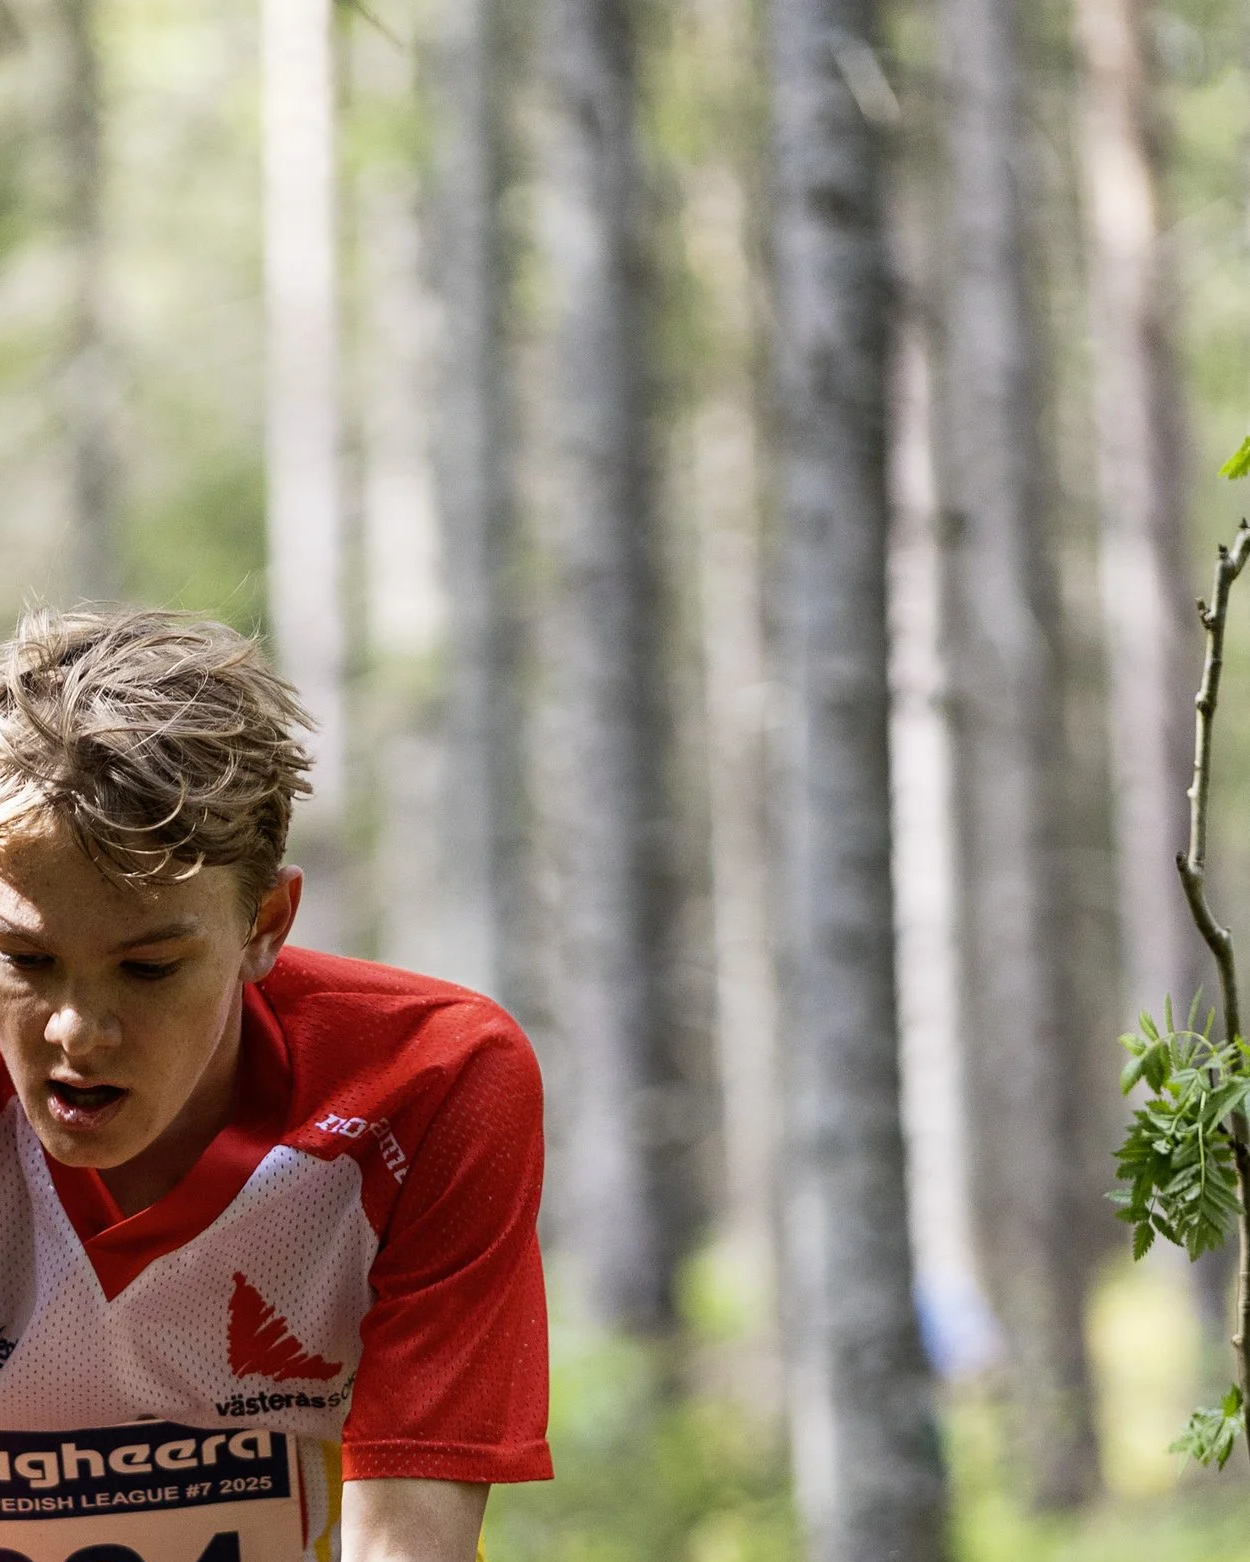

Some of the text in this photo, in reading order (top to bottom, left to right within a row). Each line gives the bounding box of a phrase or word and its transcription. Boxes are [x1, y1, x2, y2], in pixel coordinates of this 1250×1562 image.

[81, 1486, 180, 1508] LEAGUE
[185, 1482, 212, 1498] #7
[220, 1476, 272, 1494] 2025
